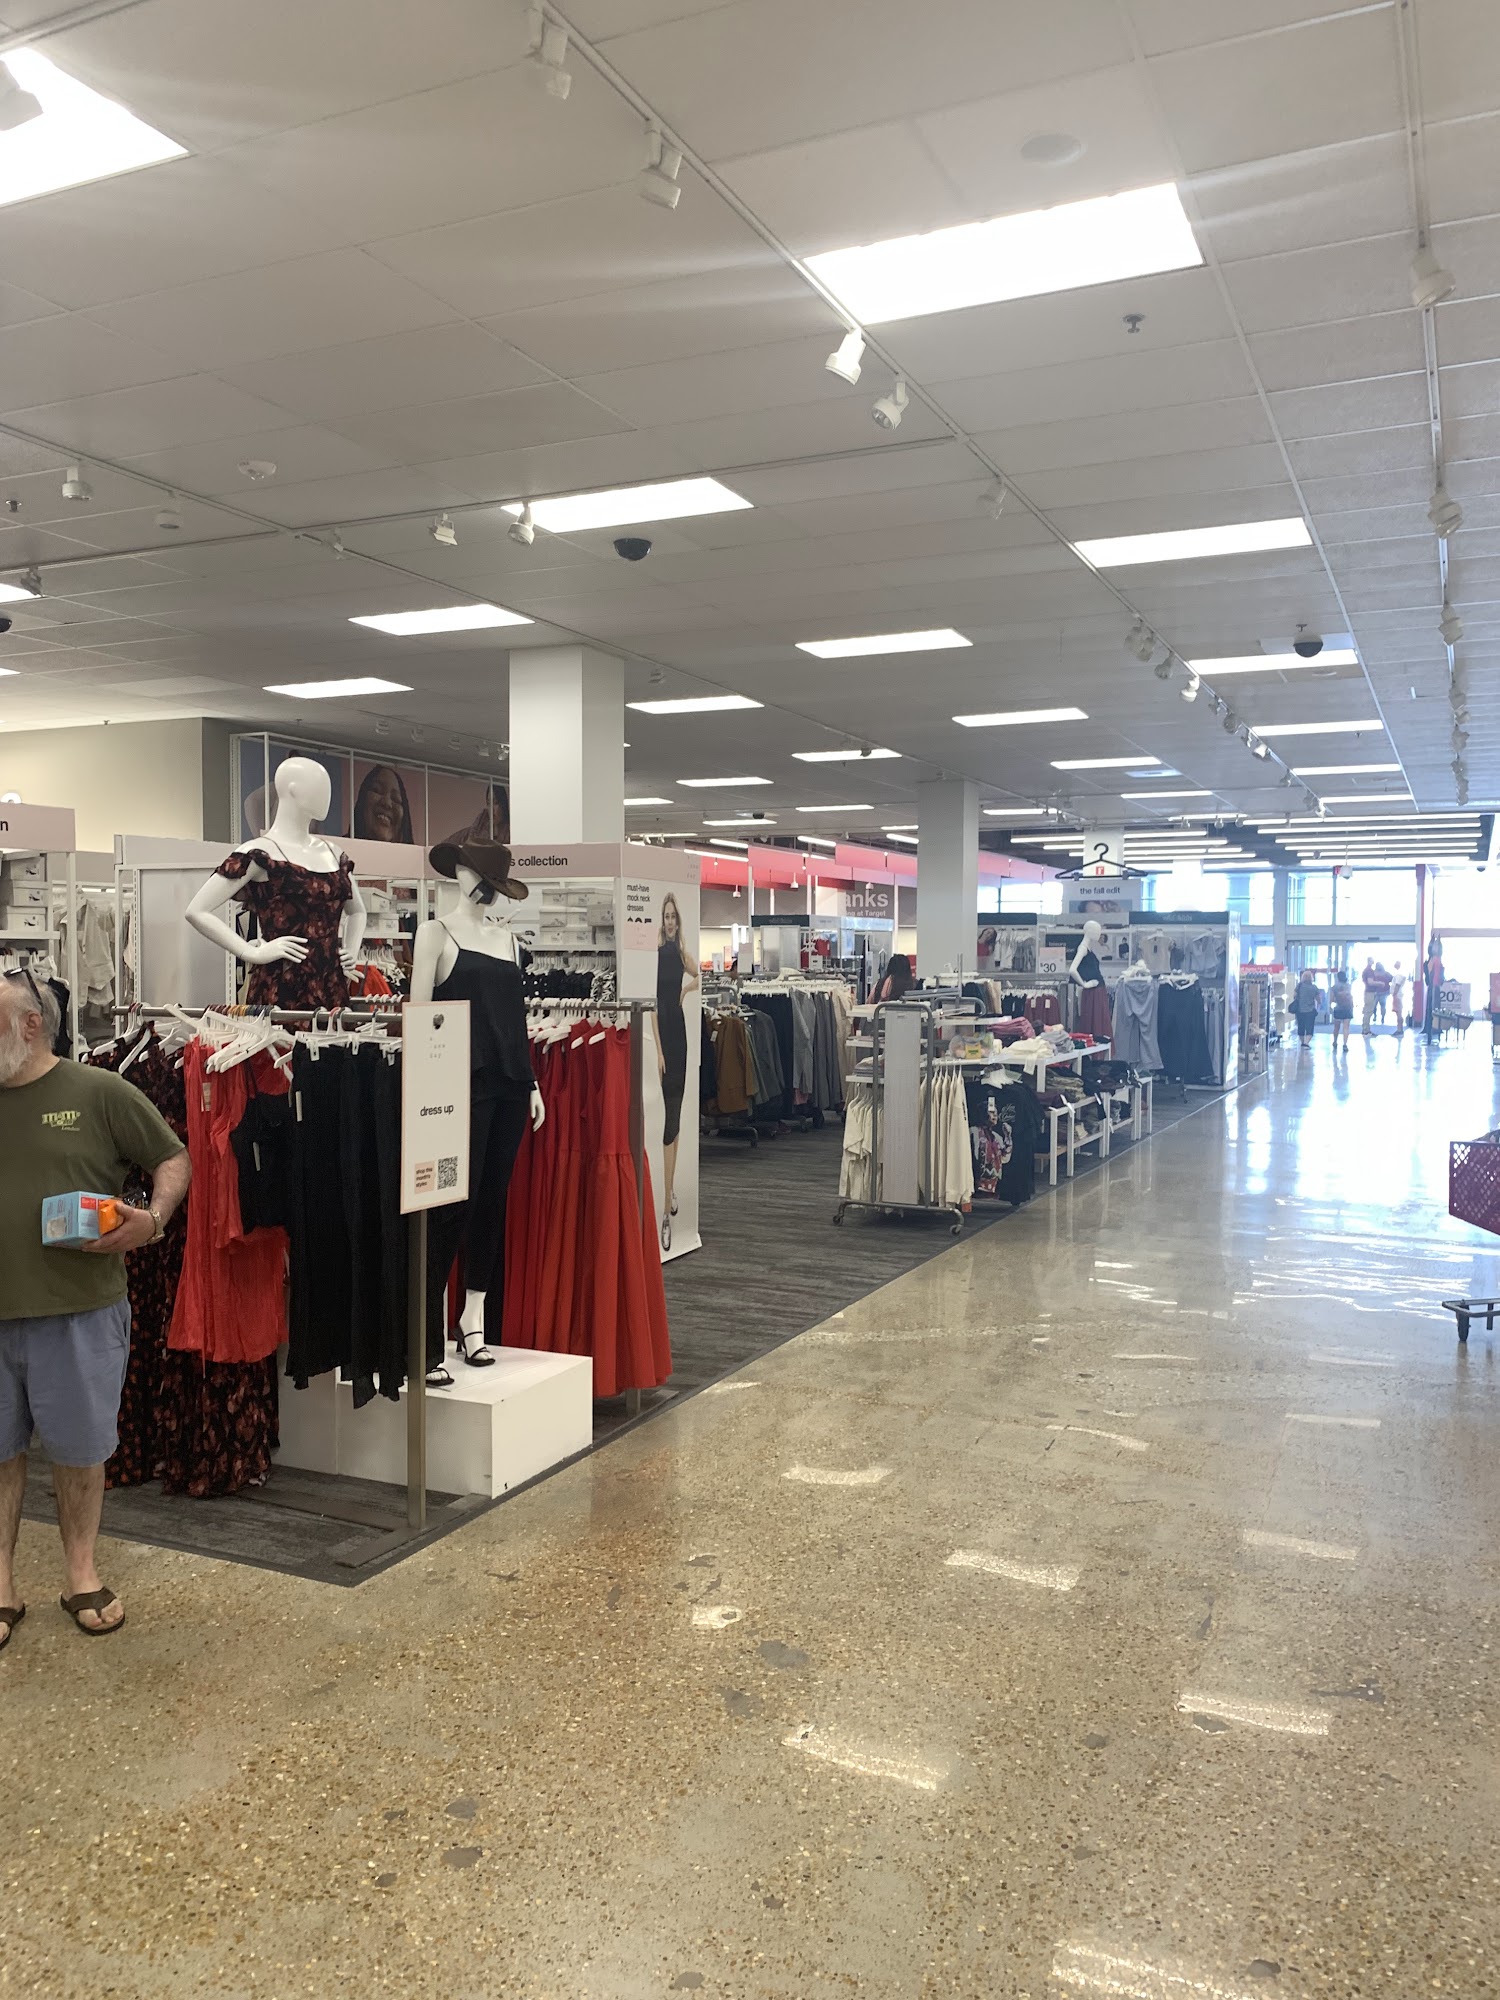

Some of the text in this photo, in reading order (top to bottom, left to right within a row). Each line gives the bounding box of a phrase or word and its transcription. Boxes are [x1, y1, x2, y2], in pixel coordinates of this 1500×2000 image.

[518, 856, 568, 866] collection
[627, 884, 650, 892] must-have
[1106, 886, 1120, 894] edit
[627, 903, 644, 912] dresses
[420, 1104, 454, 1116] dress up
